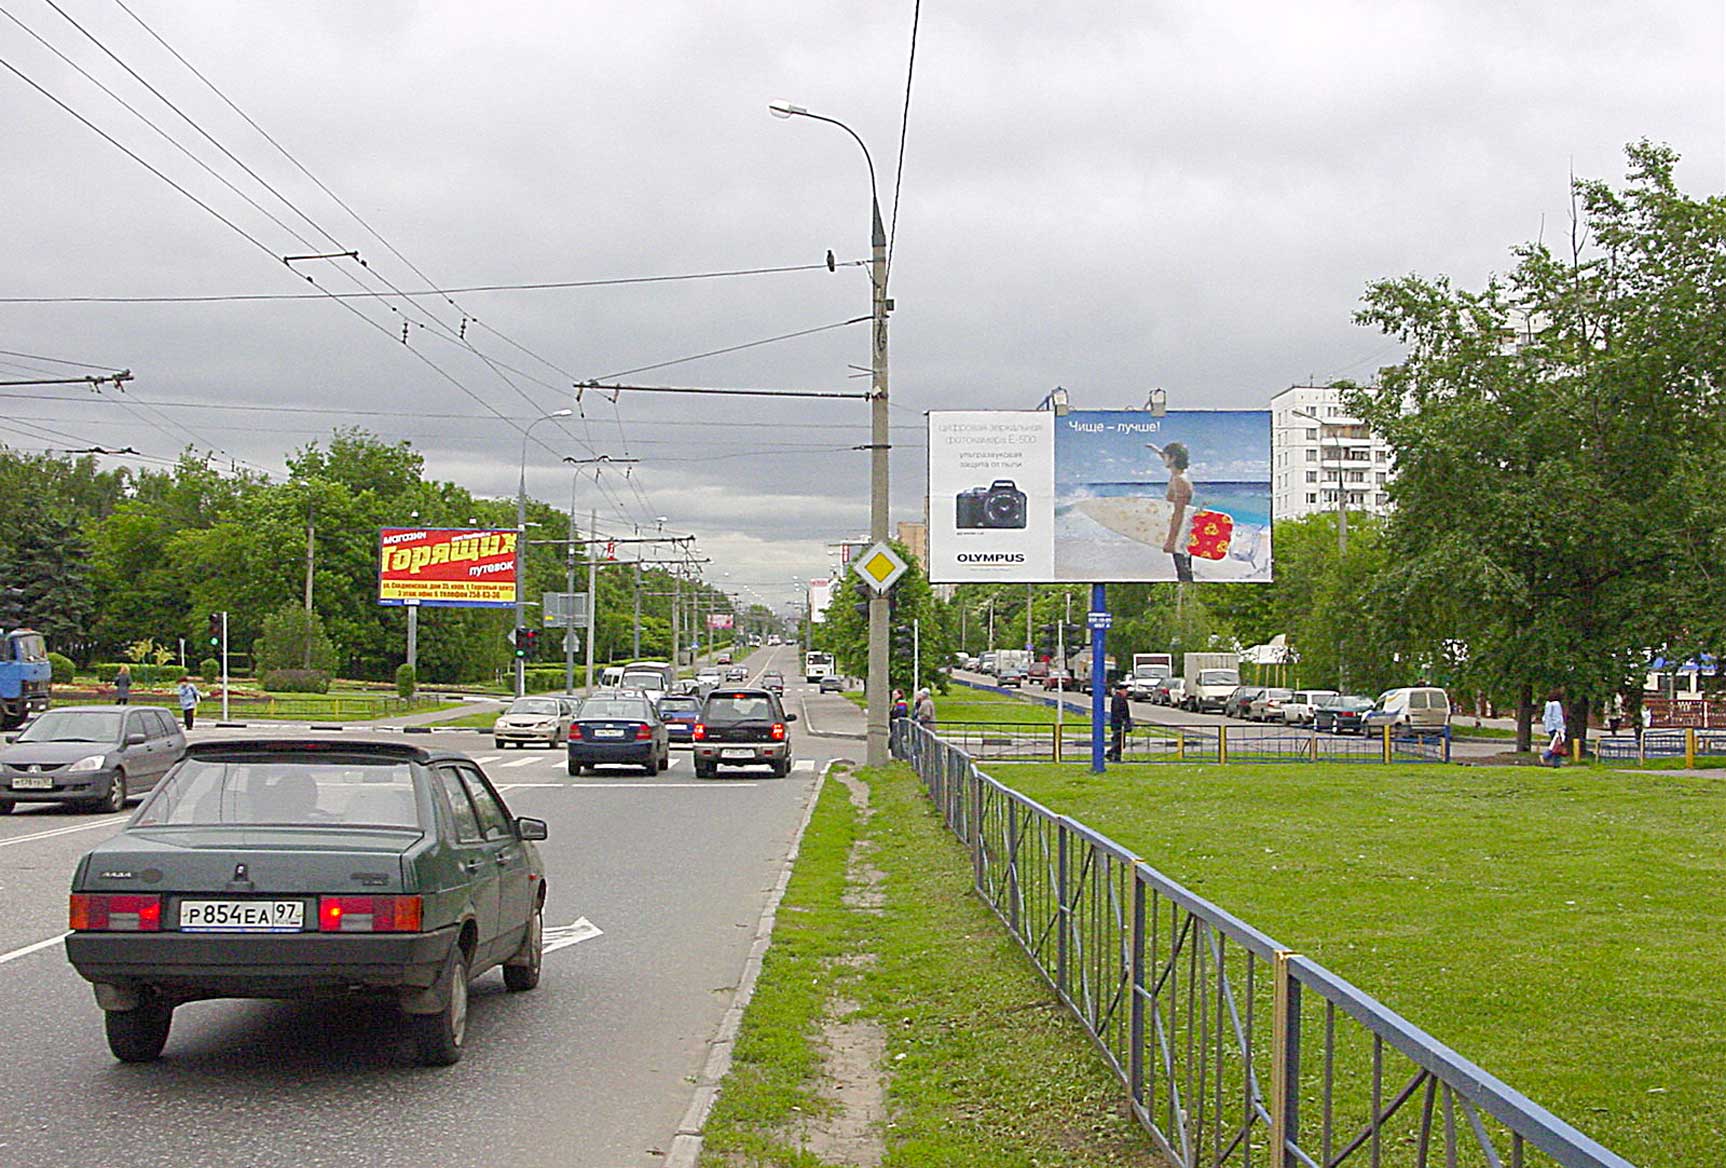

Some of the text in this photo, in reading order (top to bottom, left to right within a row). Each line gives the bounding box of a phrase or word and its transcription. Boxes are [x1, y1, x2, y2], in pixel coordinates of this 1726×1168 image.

[1068, 421, 1104, 433] Чище
[1117, 421, 1161, 435] лучше!
[381, 533, 518, 574] Горящих
[957, 553, 1026, 563] OLYMPUS
[276, 903, 296, 919] 97
